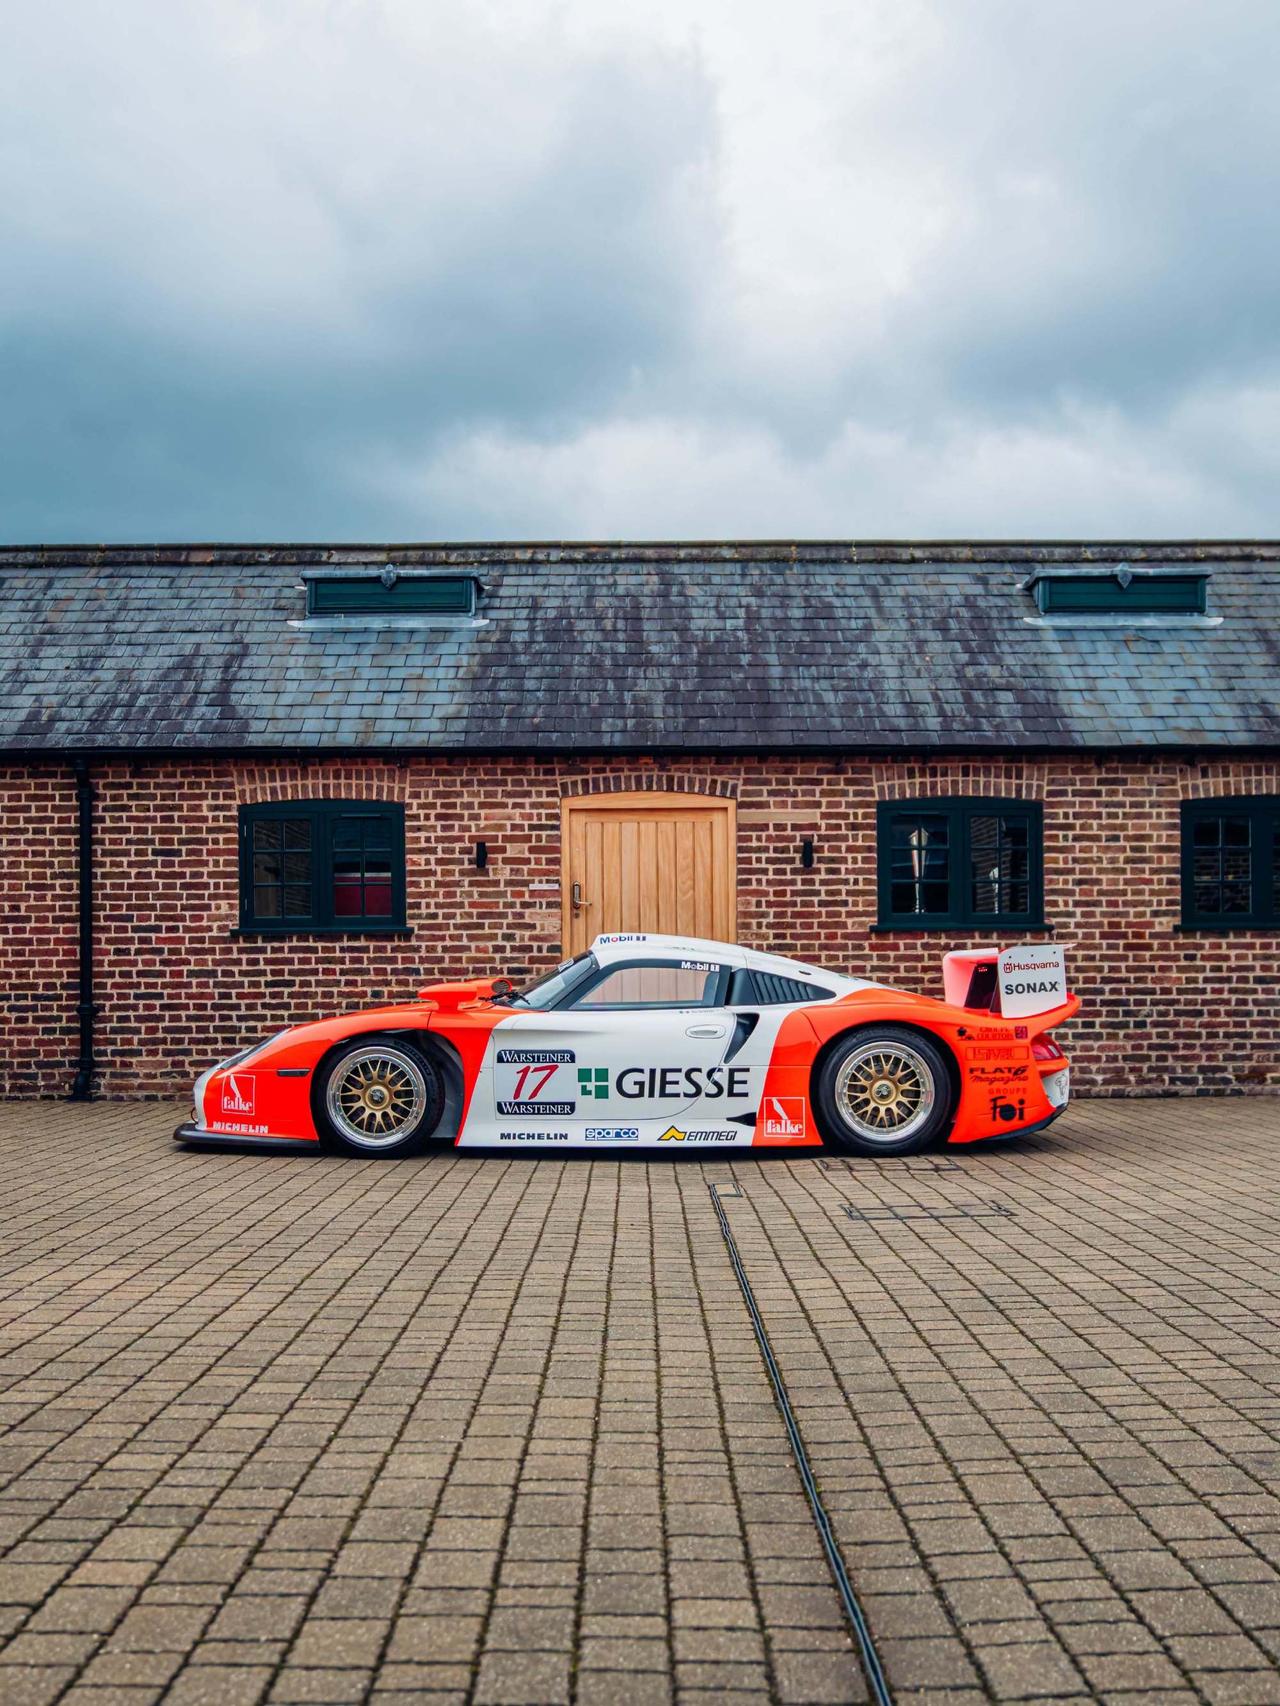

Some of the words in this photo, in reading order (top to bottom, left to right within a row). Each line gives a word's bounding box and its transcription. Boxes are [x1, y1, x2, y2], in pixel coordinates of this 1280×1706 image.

[600, 936, 633, 944] Mobil
[681, 961, 709, 971] Mobil
[1013, 961, 1060, 971] Husqvarna
[1005, 981, 1059, 995] SONAX
[513, 1064, 559, 1101] 17
[615, 1067, 750, 1100] GIESSE
[988, 1087, 1027, 1095] GROUPE
[223, 1096, 253, 1112] falke
[212, 1121, 269, 1134] MICHELIN
[766, 1119, 803, 1134] falke
[500, 1132, 569, 1141] MICHELIN
[585, 1128, 639, 1141] sparco
[687, 1130, 737, 1142] EMMEGI
